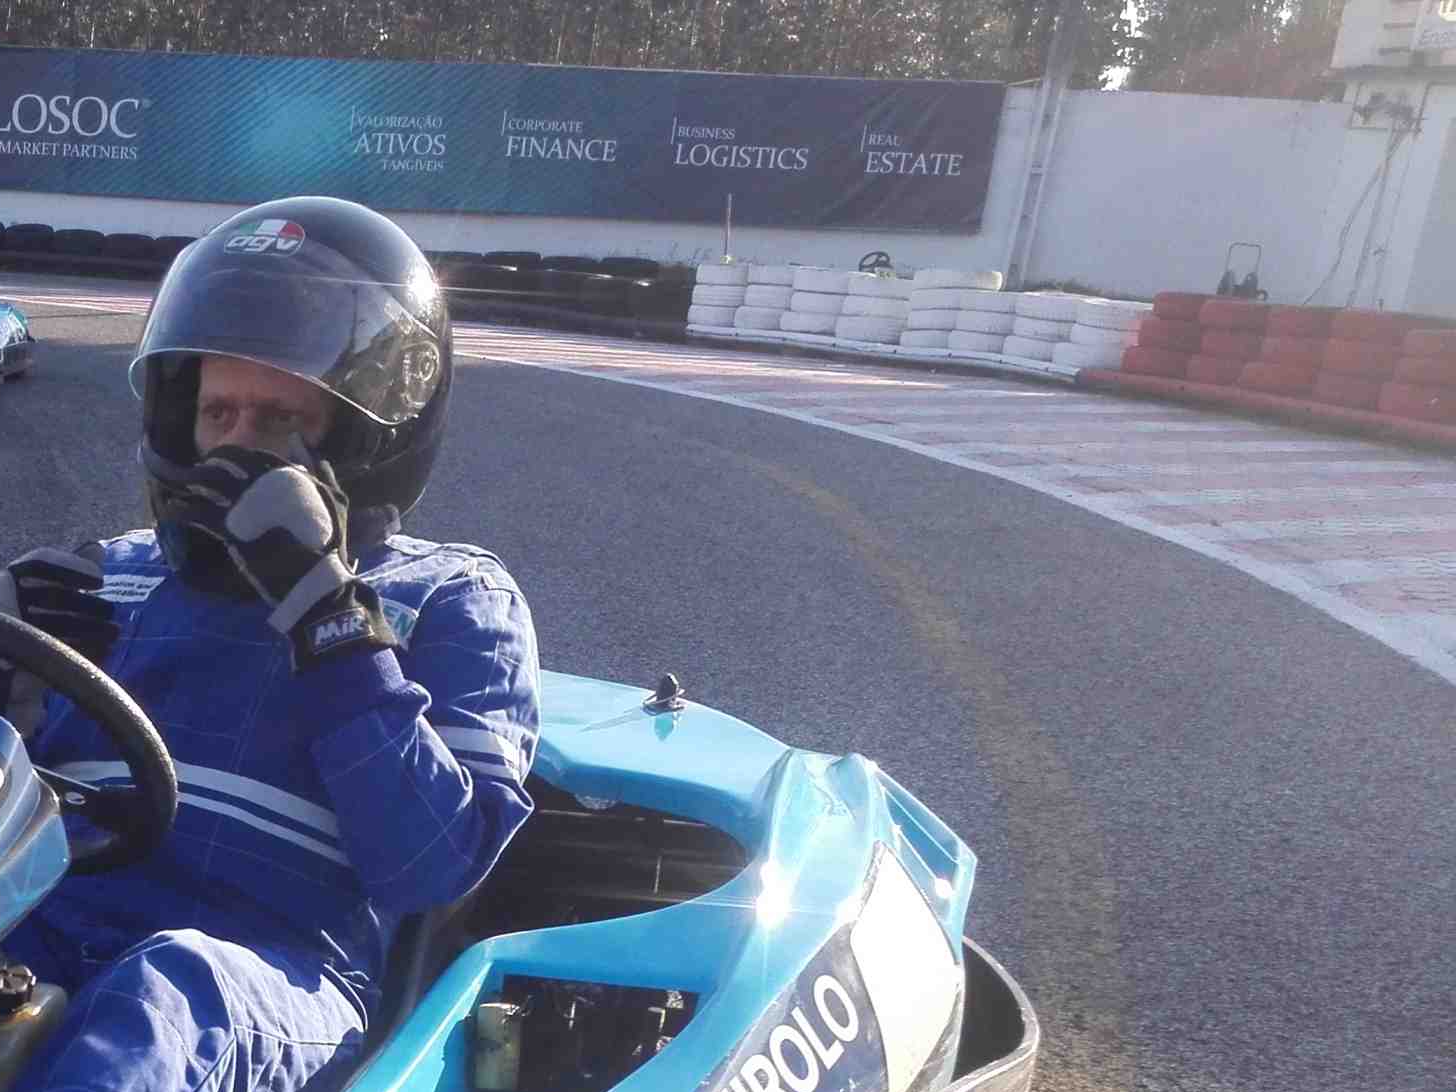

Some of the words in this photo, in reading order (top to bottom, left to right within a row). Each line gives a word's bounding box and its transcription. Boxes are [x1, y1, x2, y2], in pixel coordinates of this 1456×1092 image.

[508, 117, 583, 133] CORPORATE
[677, 126, 736, 140] BUSINESS
[353, 132, 447, 156] ATIVOS
[505, 135, 617, 163] FINANCE
[868, 133, 901, 147] REAL
[62, 143, 138, 160] PARTNERS
[673, 142, 809, 171] LOGISTICS
[864, 151, 963, 176] ESTATE
[226, 234, 300, 252] agv
